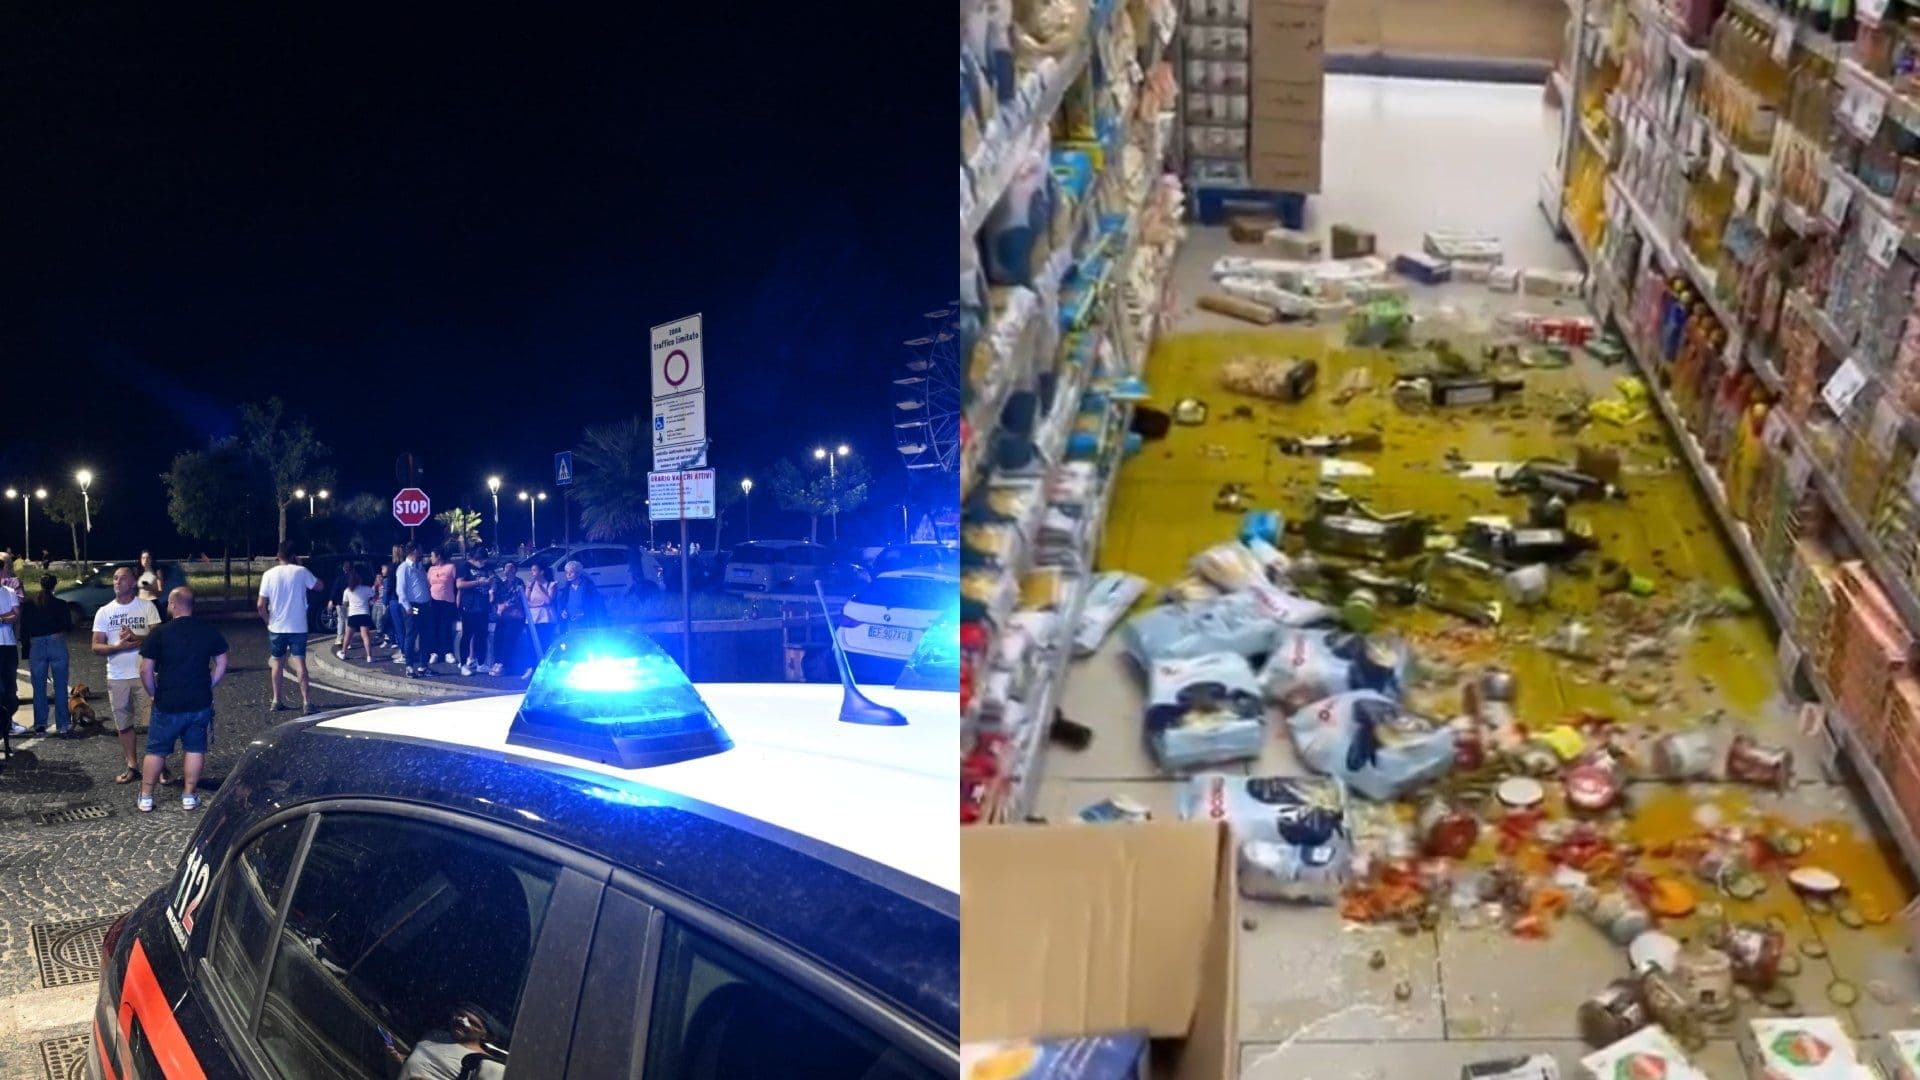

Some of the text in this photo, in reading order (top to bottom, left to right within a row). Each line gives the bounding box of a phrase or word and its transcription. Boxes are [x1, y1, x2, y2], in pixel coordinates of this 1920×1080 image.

[669, 327, 681, 336] zona
[653, 331, 699, 350] traffico limitato
[671, 472, 693, 482] VACHI
[693, 472, 712, 481] ATTIVI
[395, 500, 427, 514] STOP
[173, 846, 210, 937] 112
